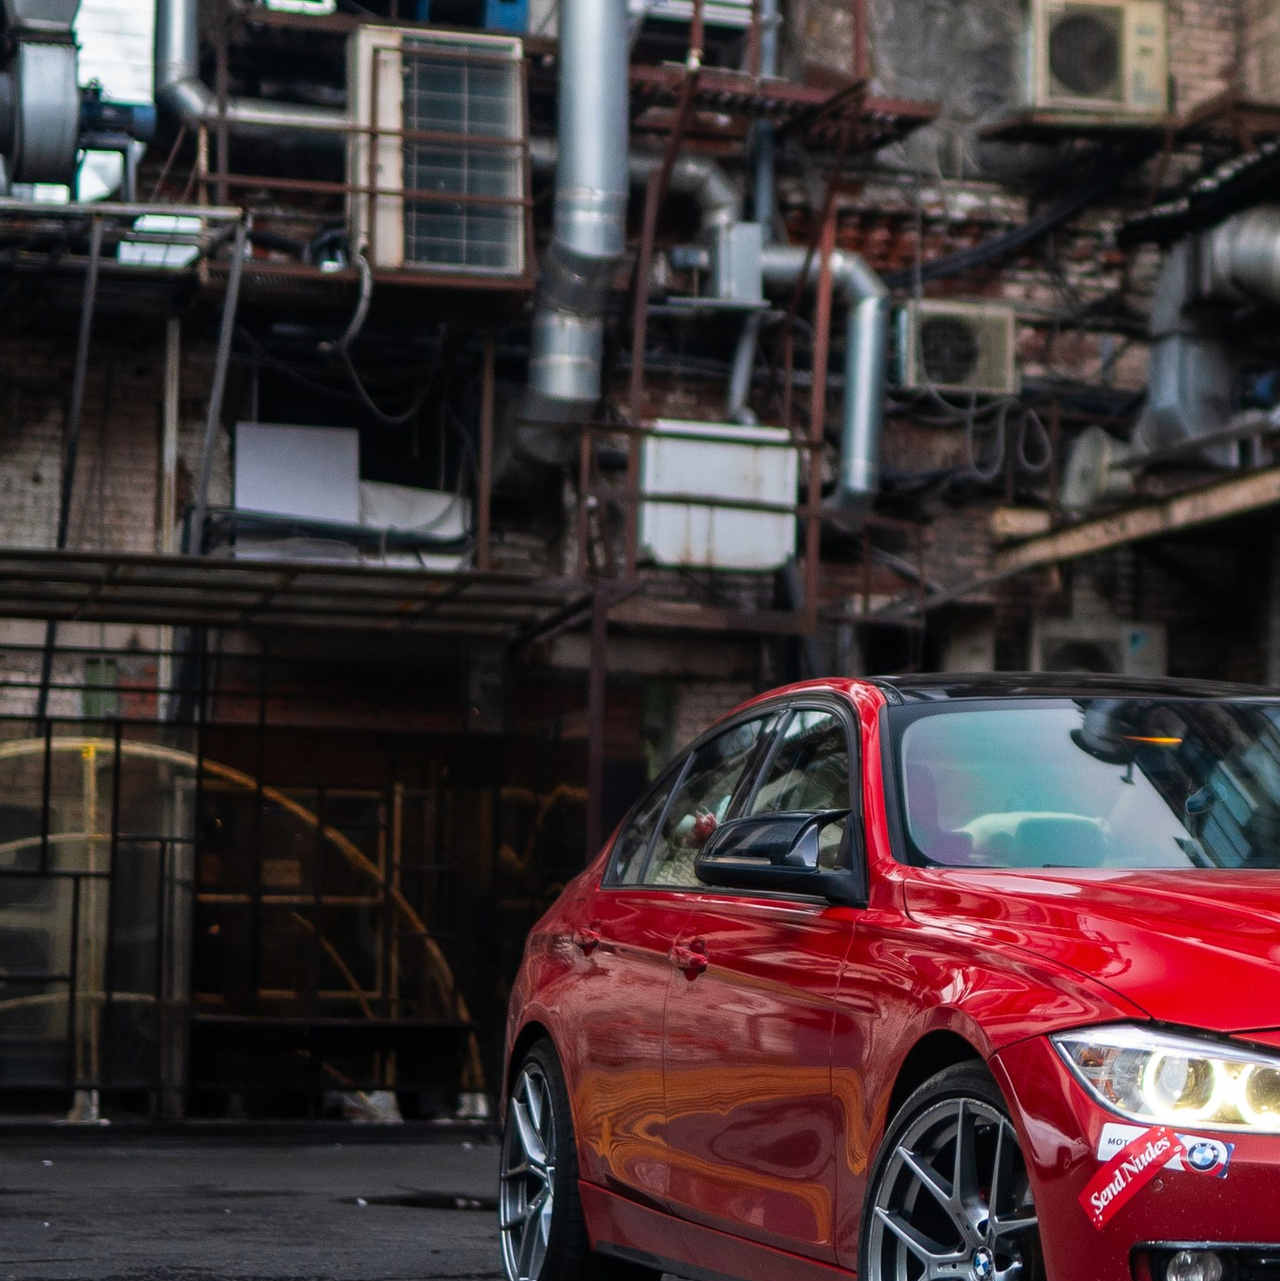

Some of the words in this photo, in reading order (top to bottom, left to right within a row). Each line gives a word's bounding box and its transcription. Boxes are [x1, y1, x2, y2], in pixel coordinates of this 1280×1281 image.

[1107, 1137, 1133, 1147] MOT
[1090, 1169, 1126, 1214] Send
[1121, 1136, 1171, 1183] Nudes
